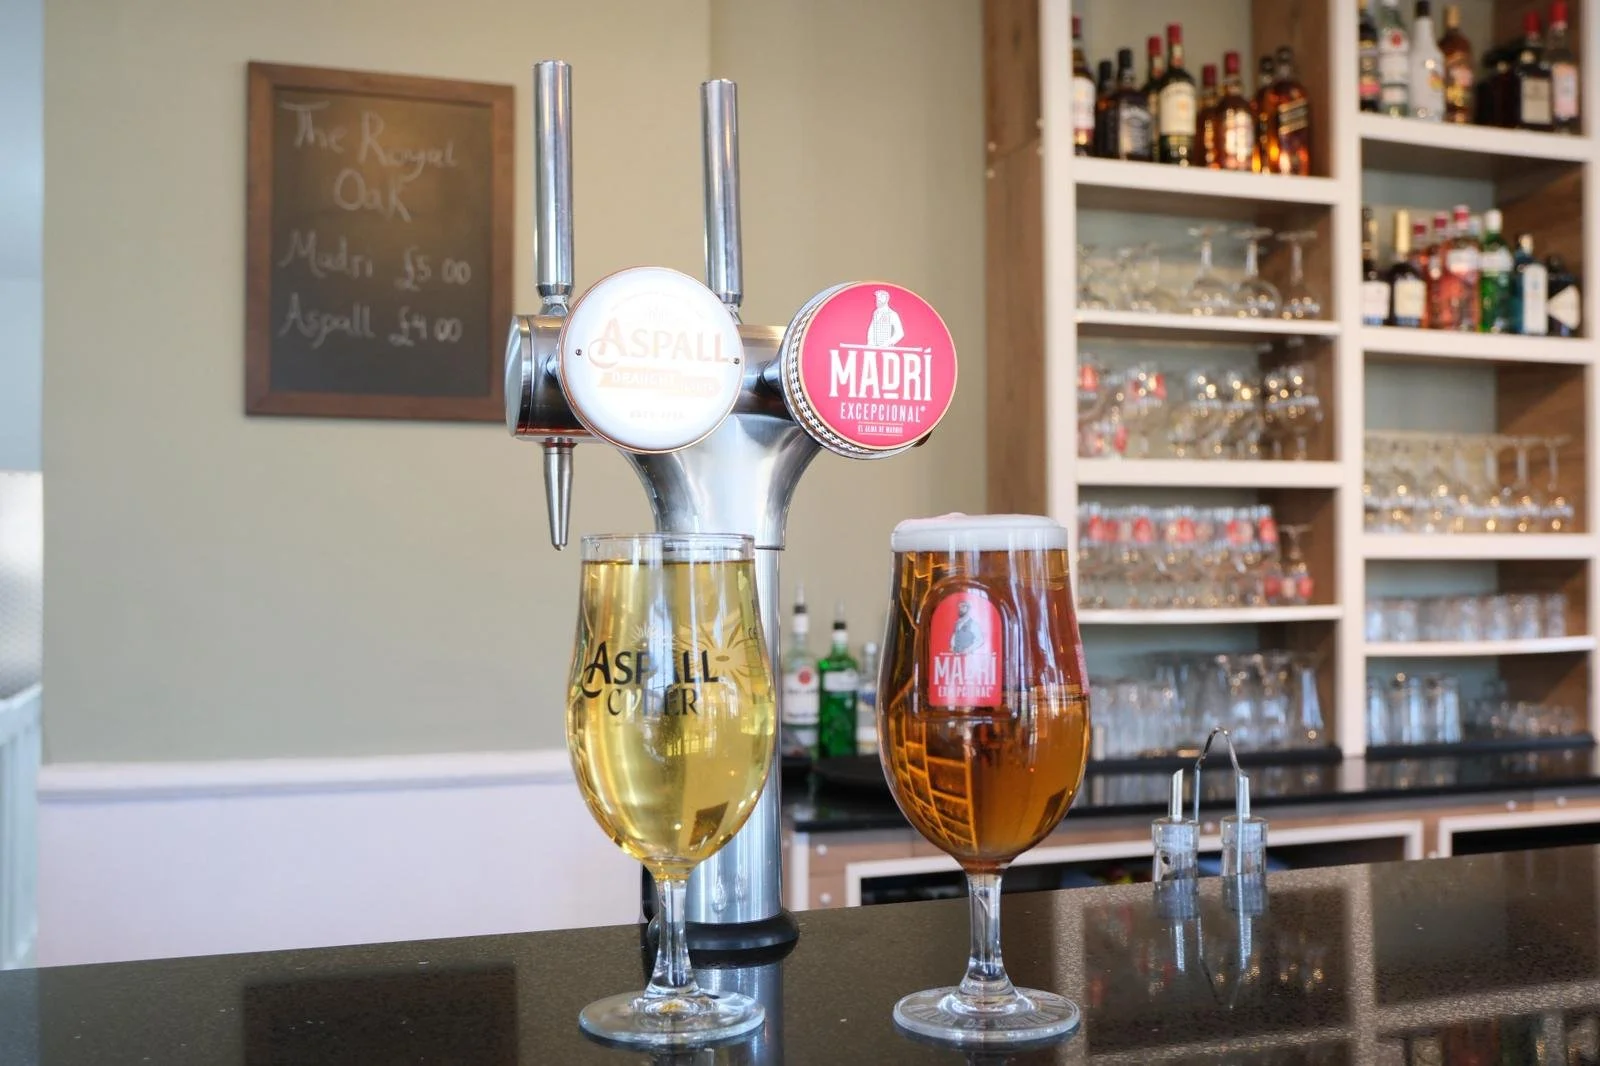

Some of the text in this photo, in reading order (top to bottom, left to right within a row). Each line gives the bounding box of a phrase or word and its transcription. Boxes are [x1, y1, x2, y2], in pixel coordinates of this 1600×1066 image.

[279, 100, 347, 153] The
[278, 292, 376, 348] Aspall
[588, 317, 729, 369] ASPALL
[829, 348, 932, 401] MADRÍ
